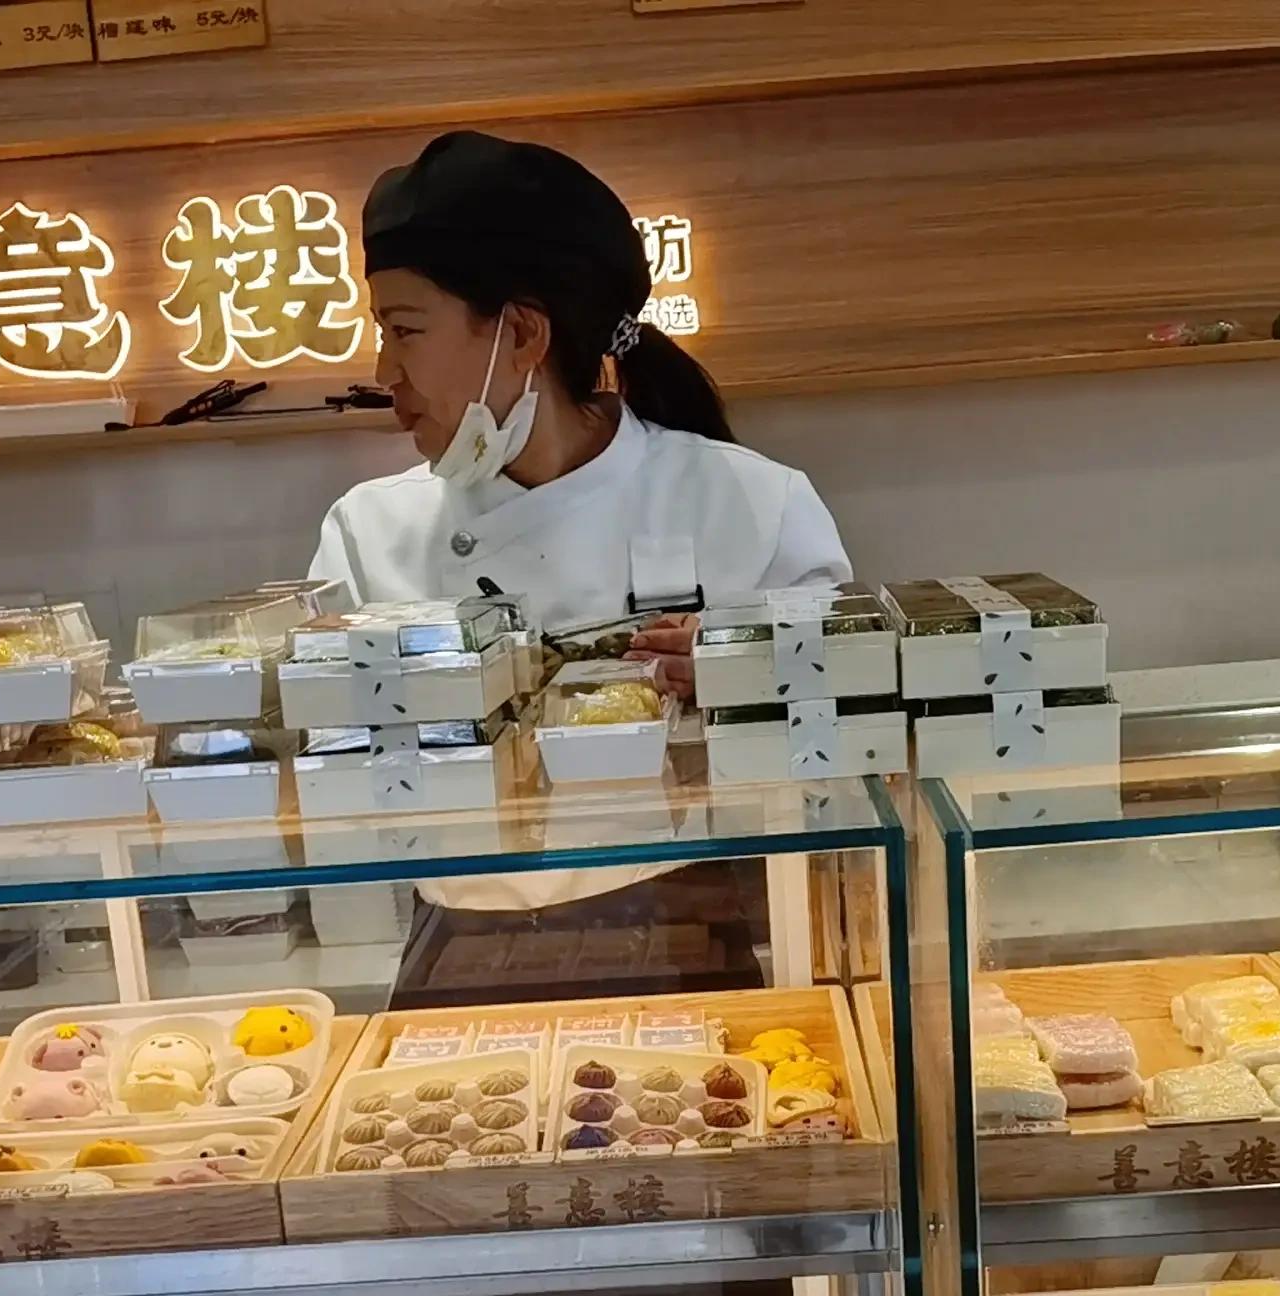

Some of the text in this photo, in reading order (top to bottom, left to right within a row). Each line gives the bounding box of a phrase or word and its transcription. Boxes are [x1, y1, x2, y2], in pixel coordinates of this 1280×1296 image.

[196, 6, 259, 27] 5元/块
[22, 23, 85, 43] 3元/块
[493, 1173, 676, 1227] 善意楼
